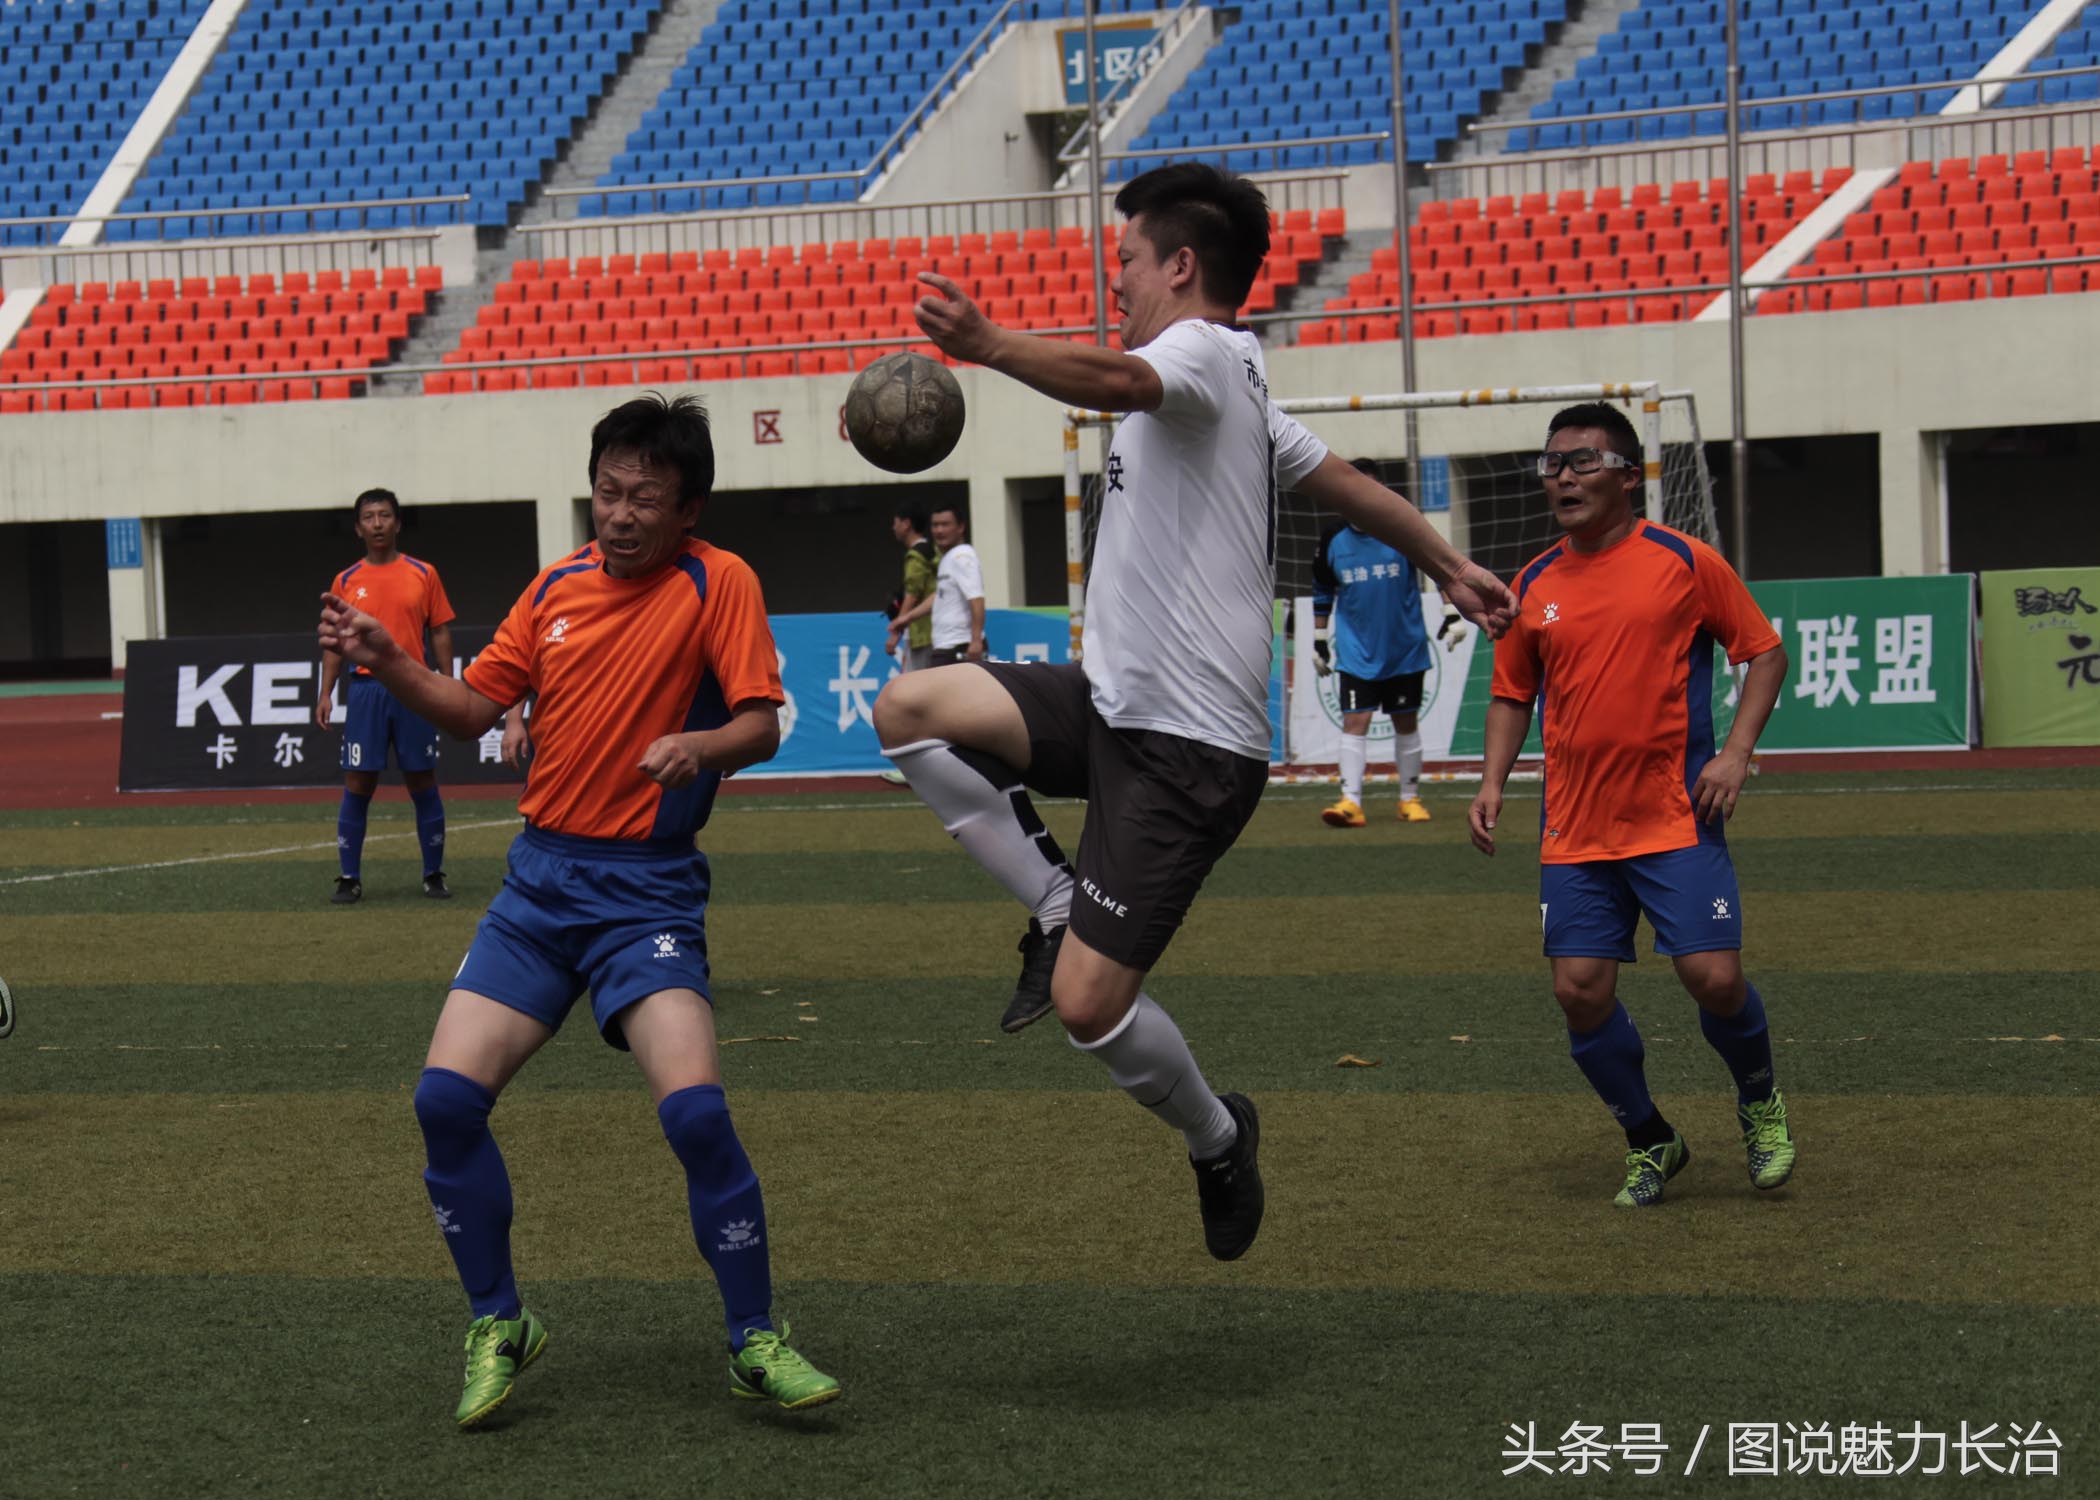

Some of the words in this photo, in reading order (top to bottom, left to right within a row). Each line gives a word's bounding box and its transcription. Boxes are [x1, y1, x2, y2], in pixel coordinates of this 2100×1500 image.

[752, 410, 784, 445] 区
[1108, 451, 1125, 494] 安
[347, 742, 361, 768] 19
[1081, 876, 1129, 918] KELME
